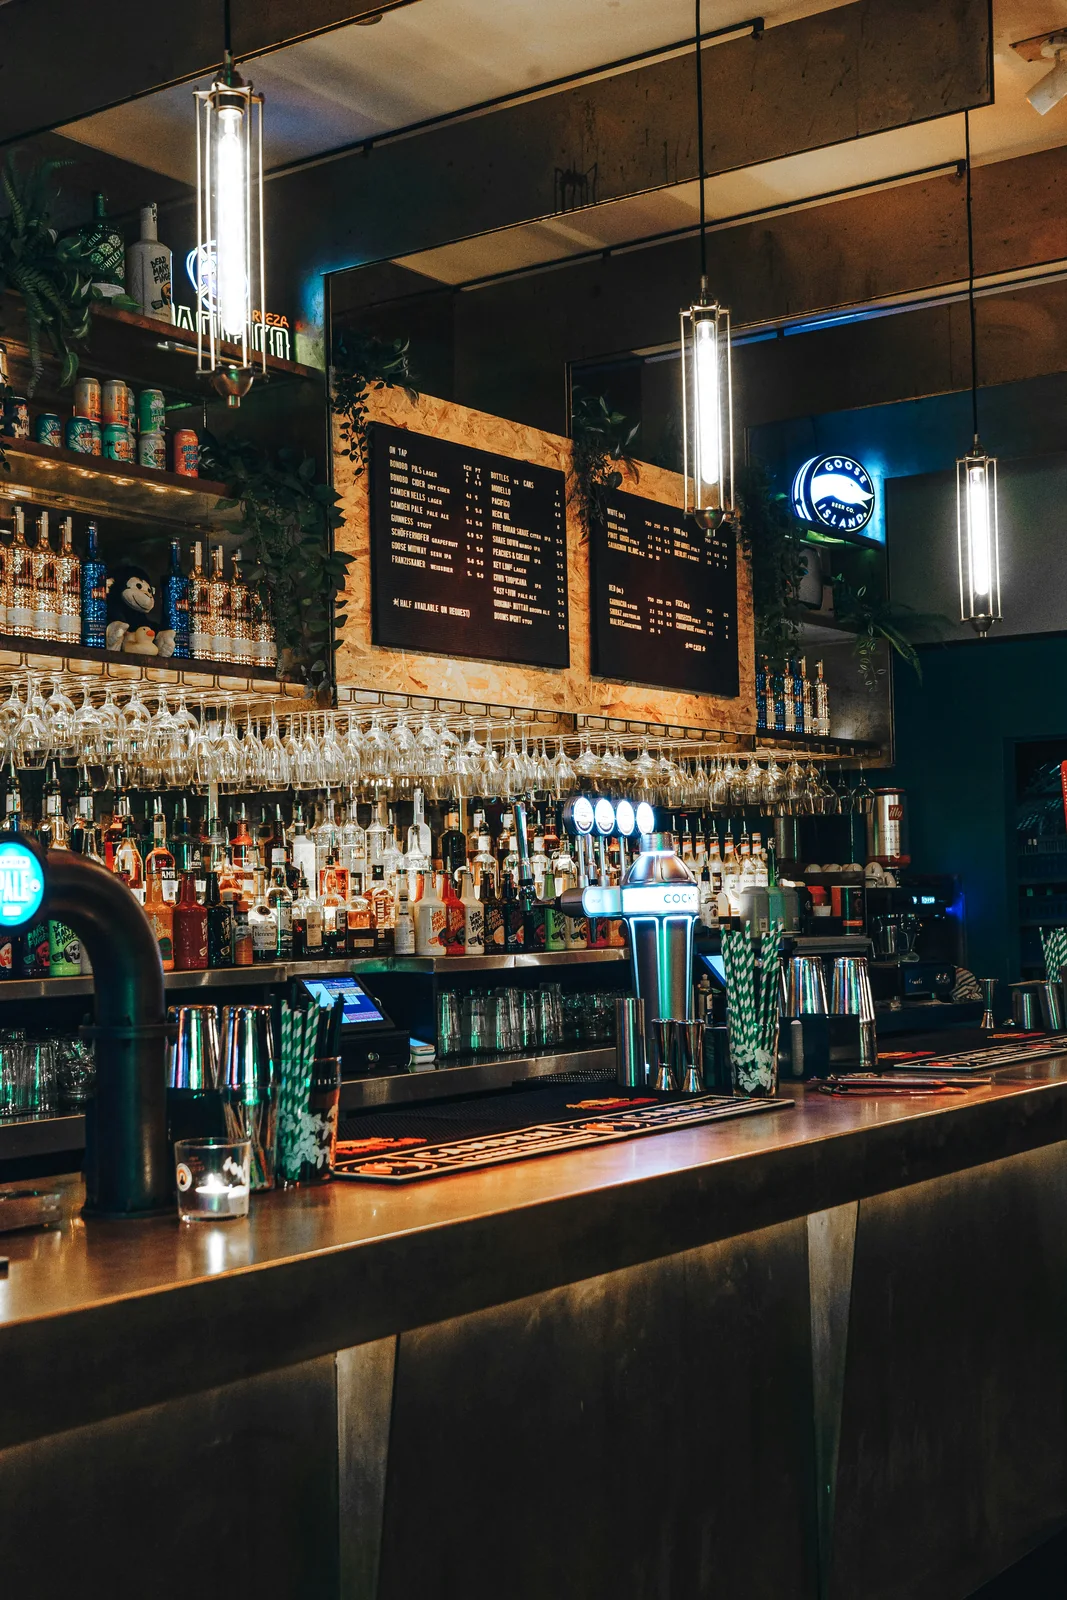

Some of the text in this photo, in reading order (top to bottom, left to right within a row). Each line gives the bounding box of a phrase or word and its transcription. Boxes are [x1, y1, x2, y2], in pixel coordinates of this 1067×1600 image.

[389, 446, 407, 457] ON TAP
[390, 460, 438, 478] BONOBO PILS LAGER
[825, 459, 867, 483] GOOSE
[390, 473, 408, 484] BONOBO
[412, 478, 425, 488] CIDER
[437, 486, 451, 494] CIDER
[491, 471, 509, 483] BOTTLES
[390, 486, 442, 505] CAMDEN HELLS LAGER
[390, 500, 410, 512] CAMDEN
[411, 504, 423, 514] PALE
[426, 510, 438, 518] PALE
[491, 497, 511, 508] PACIFICO
[832, 502, 855, 514] BEER CO.
[492, 509, 503, 519] NECK
[818, 503, 863, 528] ISLAND
[391, 514, 432, 529] GUINNESS STOUT
[492, 522, 502, 531] FIVE
[391, 541, 406, 552] GOOSE
[407, 544, 427, 555] MIDWAY
[431, 537, 458, 548] GRAPEFRUIT
[492, 535, 506, 545] SHAKE
[507, 538, 519, 548] DOWN
[493, 548, 512, 559] PEACHES
[512, 552, 515, 560] &
[516, 552, 530, 562] CREAM
[391, 555, 453, 573] FRANZISKANER WEISSBIER
[414, 601, 439, 613] AVAILABLE
[440, 605, 447, 614] ON
[609, 617, 624, 626] MALBEC
[890, 807, 903, 819] illy
[414, 1130, 562, 1159] CAMDEN
